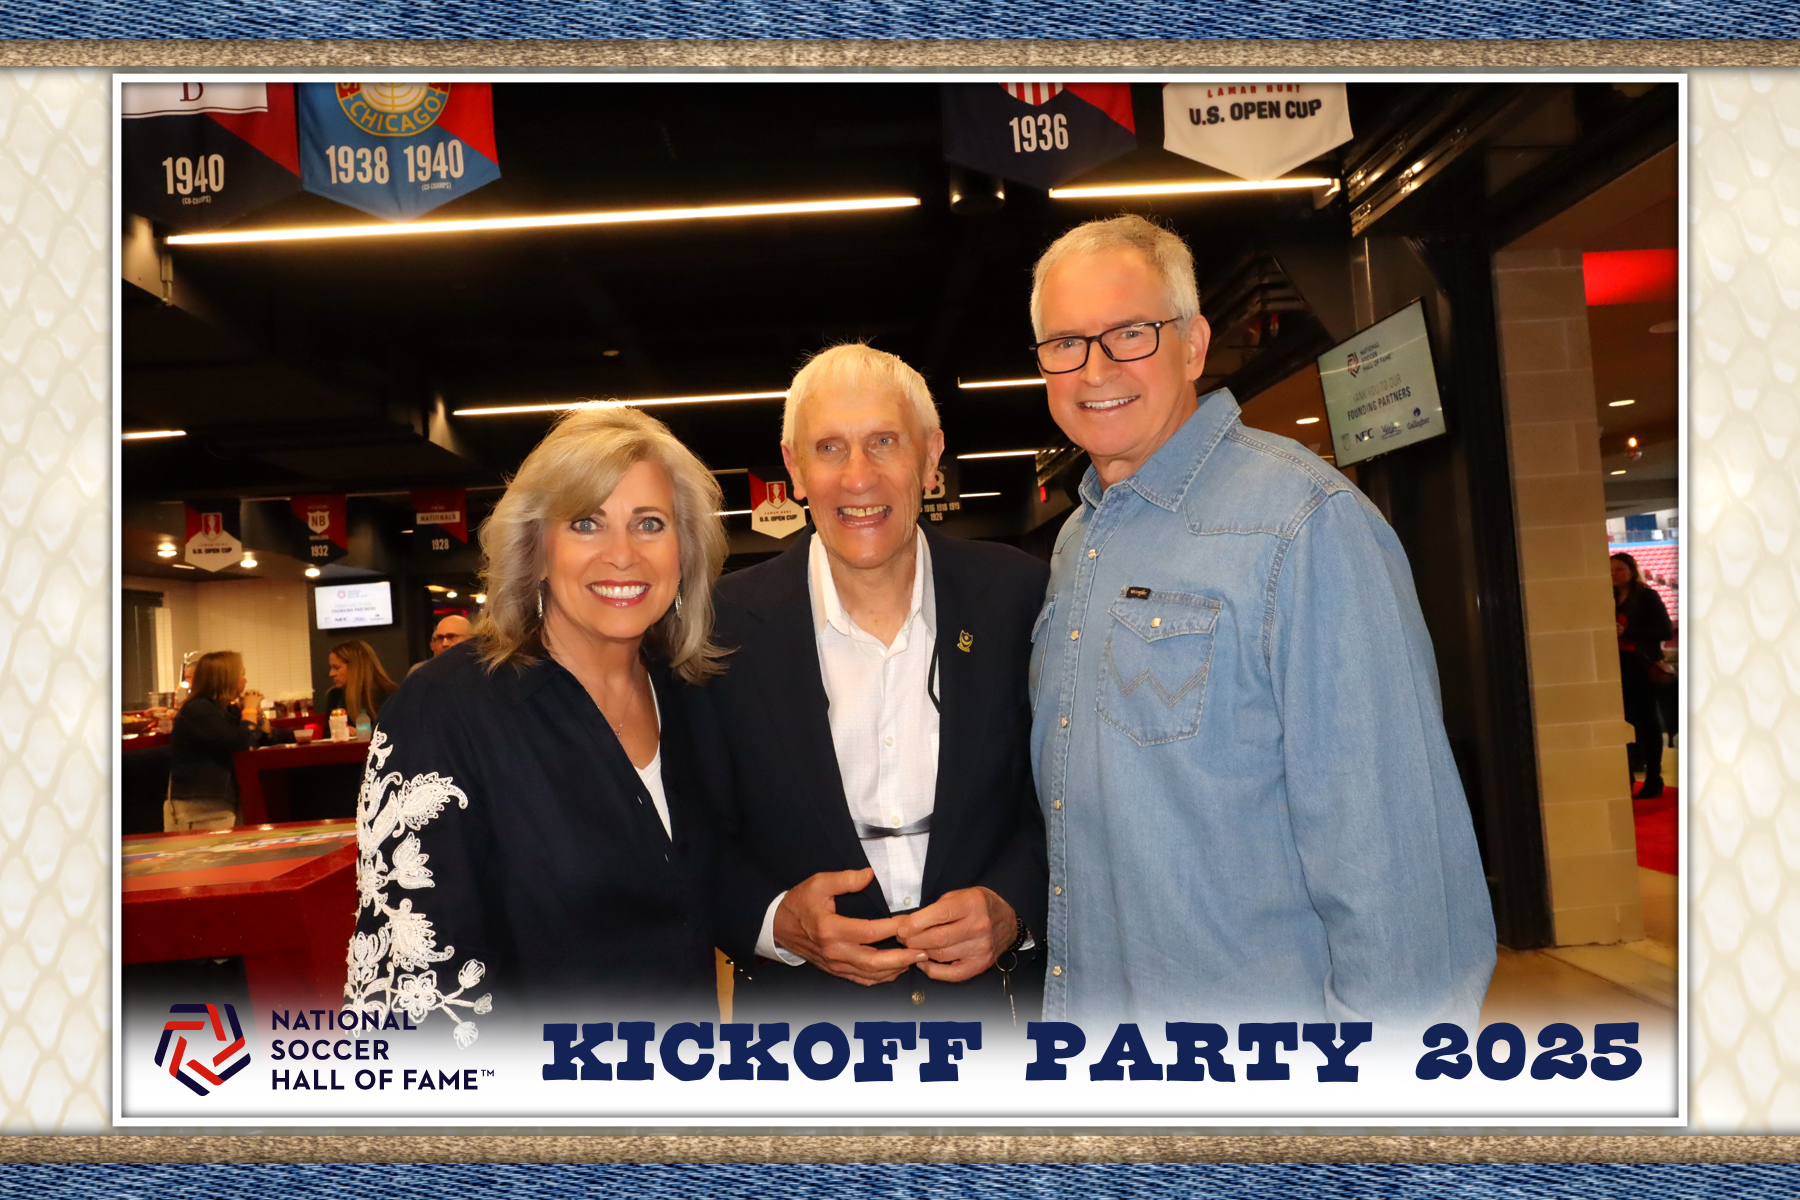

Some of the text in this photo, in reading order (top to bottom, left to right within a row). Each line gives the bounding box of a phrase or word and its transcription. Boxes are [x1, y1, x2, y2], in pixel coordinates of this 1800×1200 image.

[1207, 83, 1301, 98] LAMAR HUNT
[350, 96, 442, 132] CHICAGO
[1189, 98, 1322, 126] U.S. OPEN CUP
[1008, 113, 1069, 153] 1936
[162, 153, 225, 195] 1940
[325, 139, 465, 185] 1938 1940
[1347, 386, 1412, 421] FOUNDING PARTNERS
[311, 515, 326, 527] NB
[420, 513, 457, 522] NATIONALS
[311, 544, 329, 557] 1932
